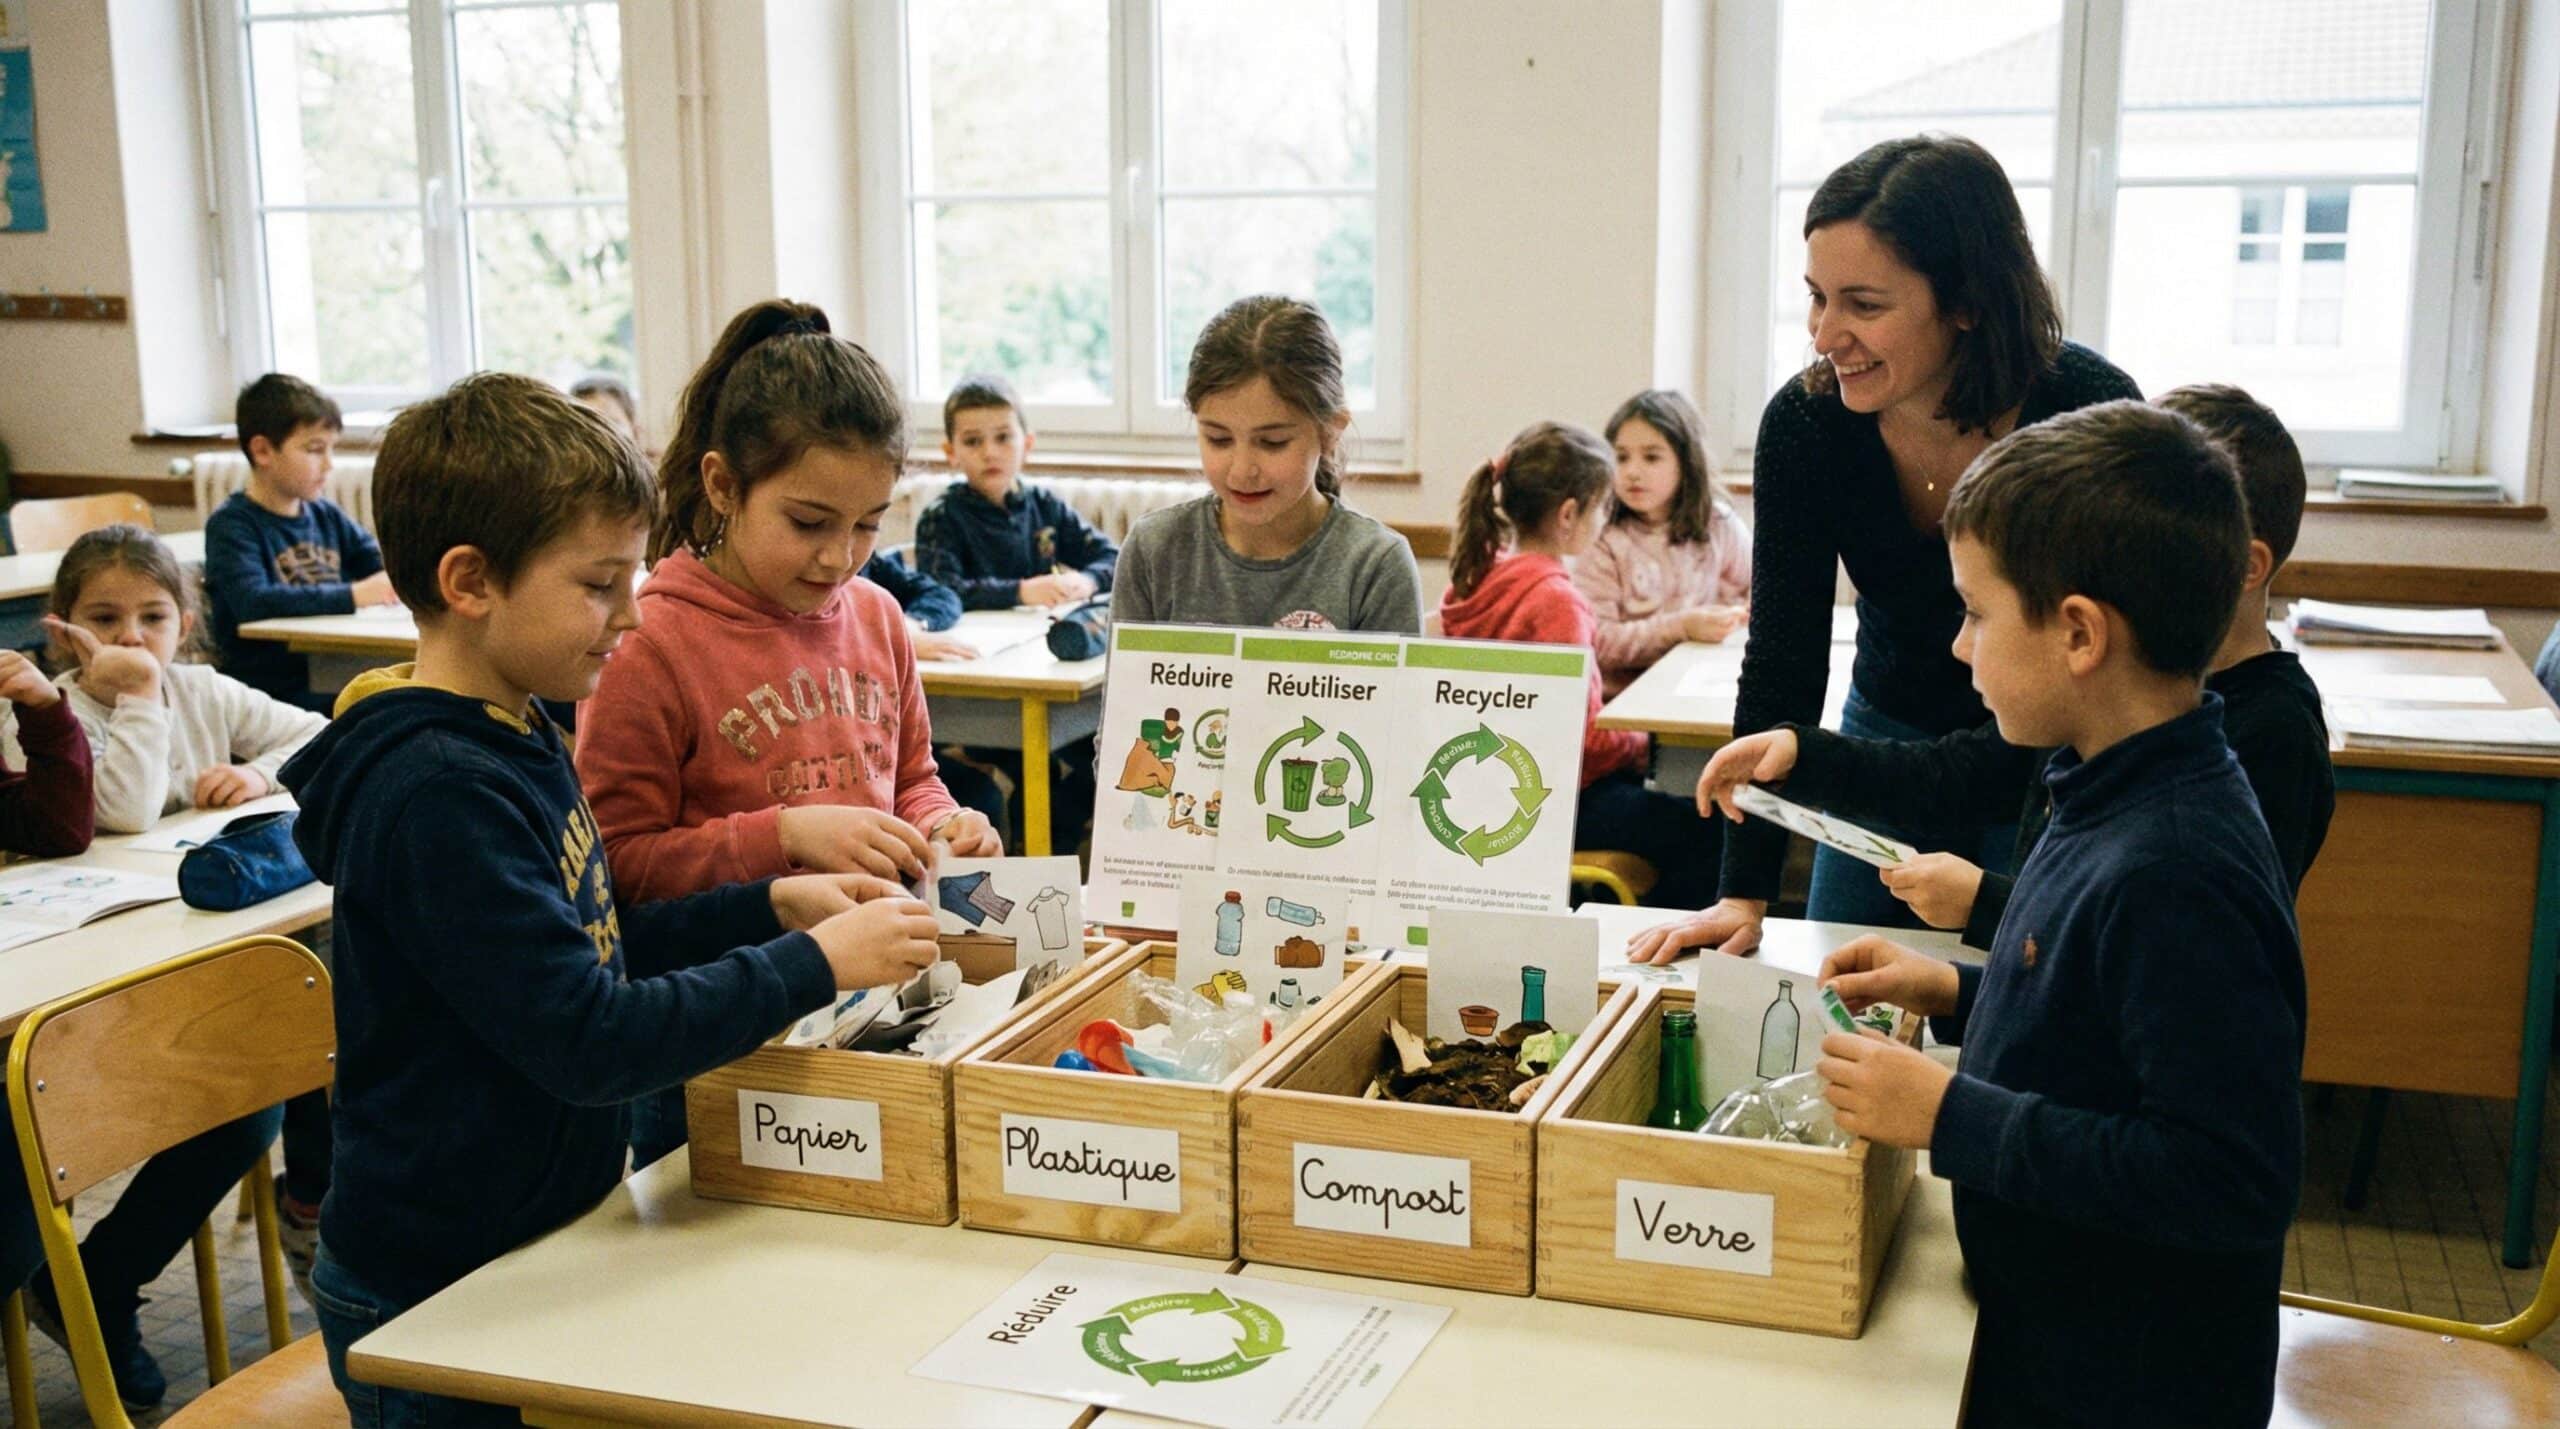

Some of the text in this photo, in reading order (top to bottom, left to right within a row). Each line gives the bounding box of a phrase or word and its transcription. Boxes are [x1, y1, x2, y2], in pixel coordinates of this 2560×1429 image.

[1151, 662, 1233, 689] Réduire
[1267, 671, 1377, 701] Réutiliser
[1435, 680, 1539, 714] Recycler
[754, 1102, 868, 1166] Papier
[1006, 1127, 1176, 1201] Plastique
[1299, 1157, 1466, 1230] Compost
[1632, 1197, 1756, 1254] Verre
[987, 1284, 1078, 1345] Réduire
